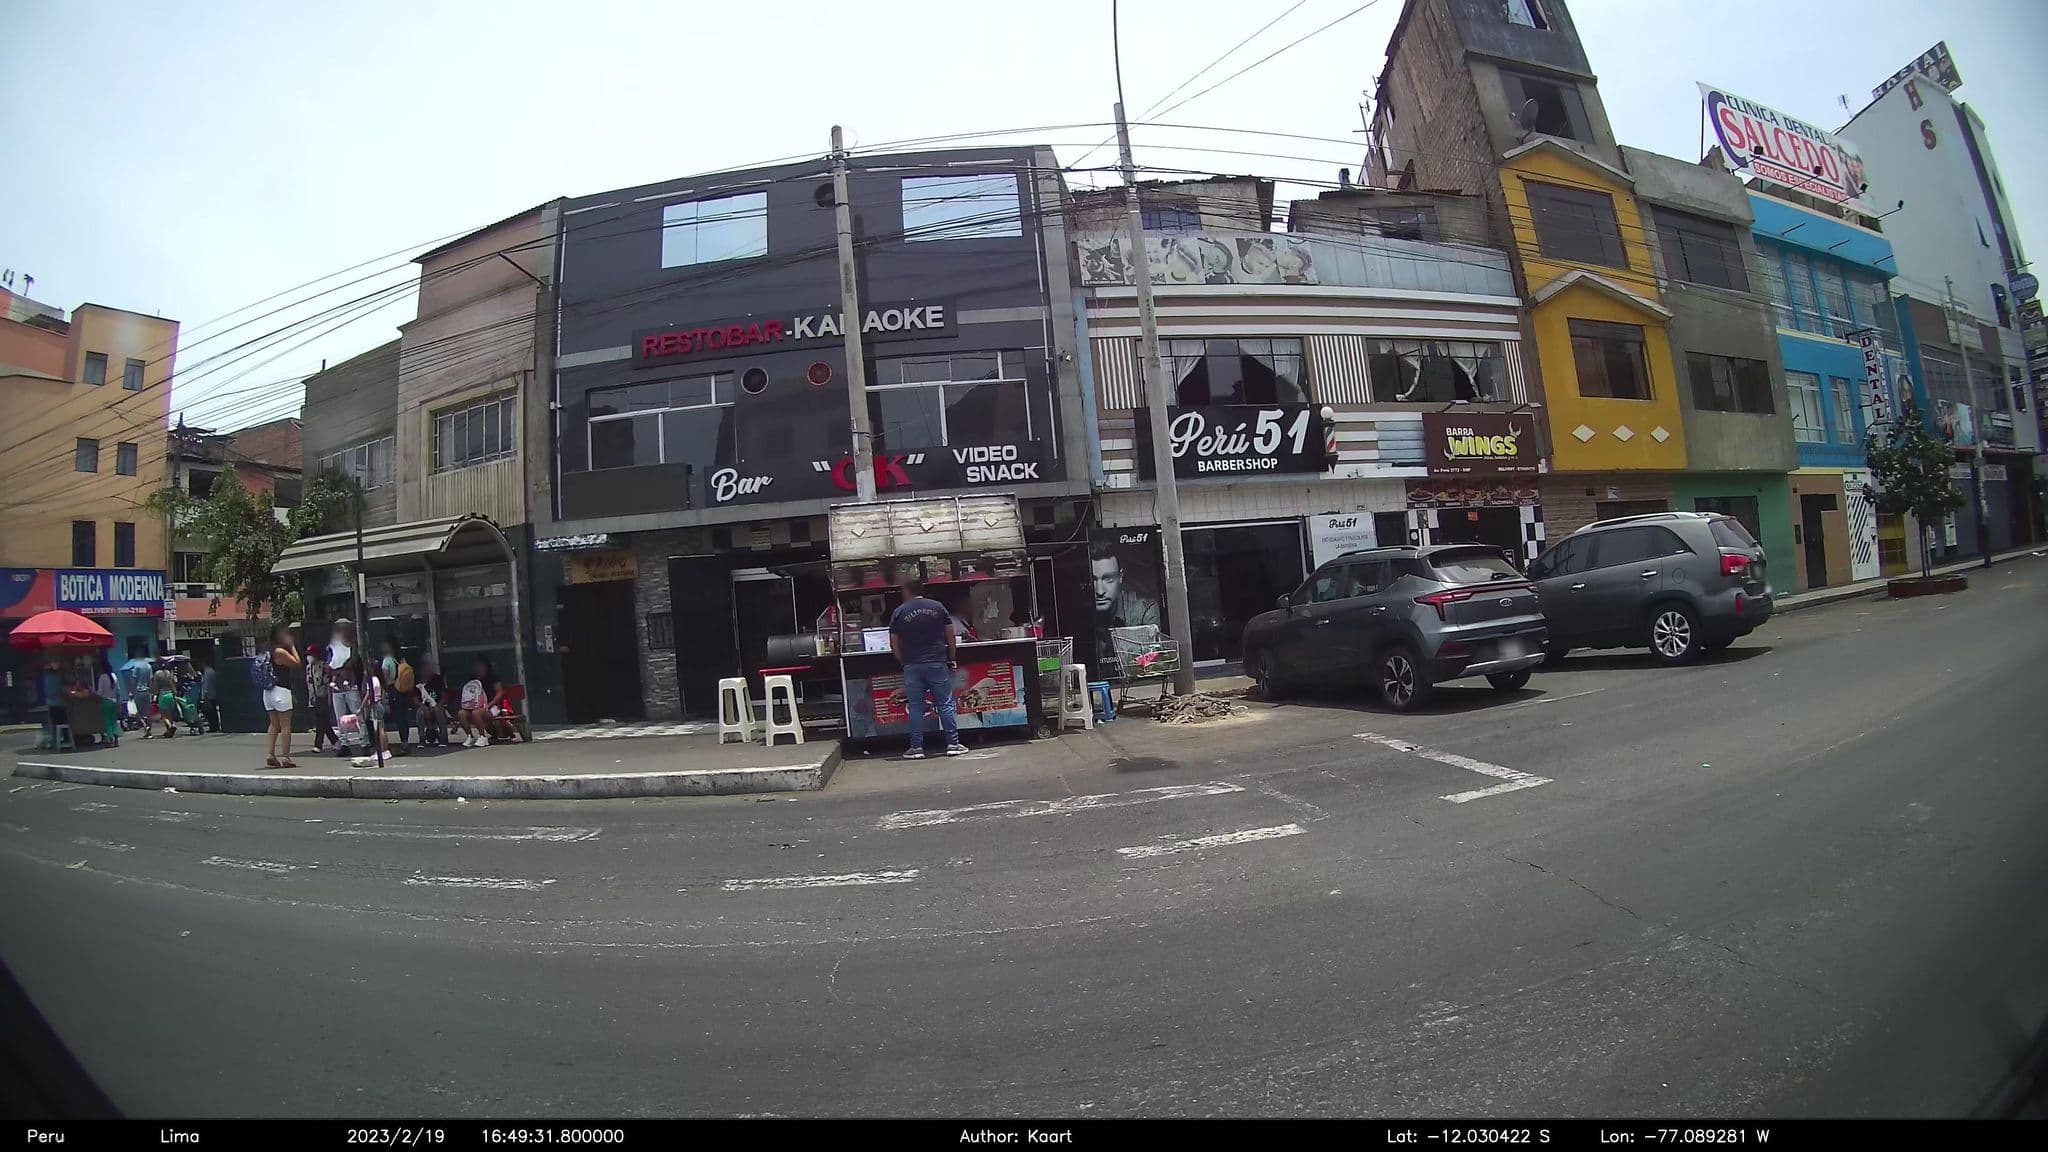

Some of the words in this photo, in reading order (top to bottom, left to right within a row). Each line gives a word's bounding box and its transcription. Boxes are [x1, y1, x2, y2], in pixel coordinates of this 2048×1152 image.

[1725, 95, 1779, 126] CLINICA
[1783, 117, 1832, 147] DENTAL
[1718, 107, 1840, 184] SALCEDO
[1753, 162, 1789, 181] SOMOS
[1860, 335, 1885, 419] DENTAL
[1169, 411, 1250, 458] Perú
[1253, 408, 1310, 455] 51
[1446, 427, 1474, 436] BARRA
[952, 445, 1018, 465] VIDEO
[1448, 435, 1518, 456] WINGS
[966, 462, 1040, 484] SNACK
[1197, 457, 1279, 473] BARBERSHOP
[710, 467, 773, 502] Bar
[61, 574, 104, 601] BOTICA
[109, 575, 165, 601] MODERNA
